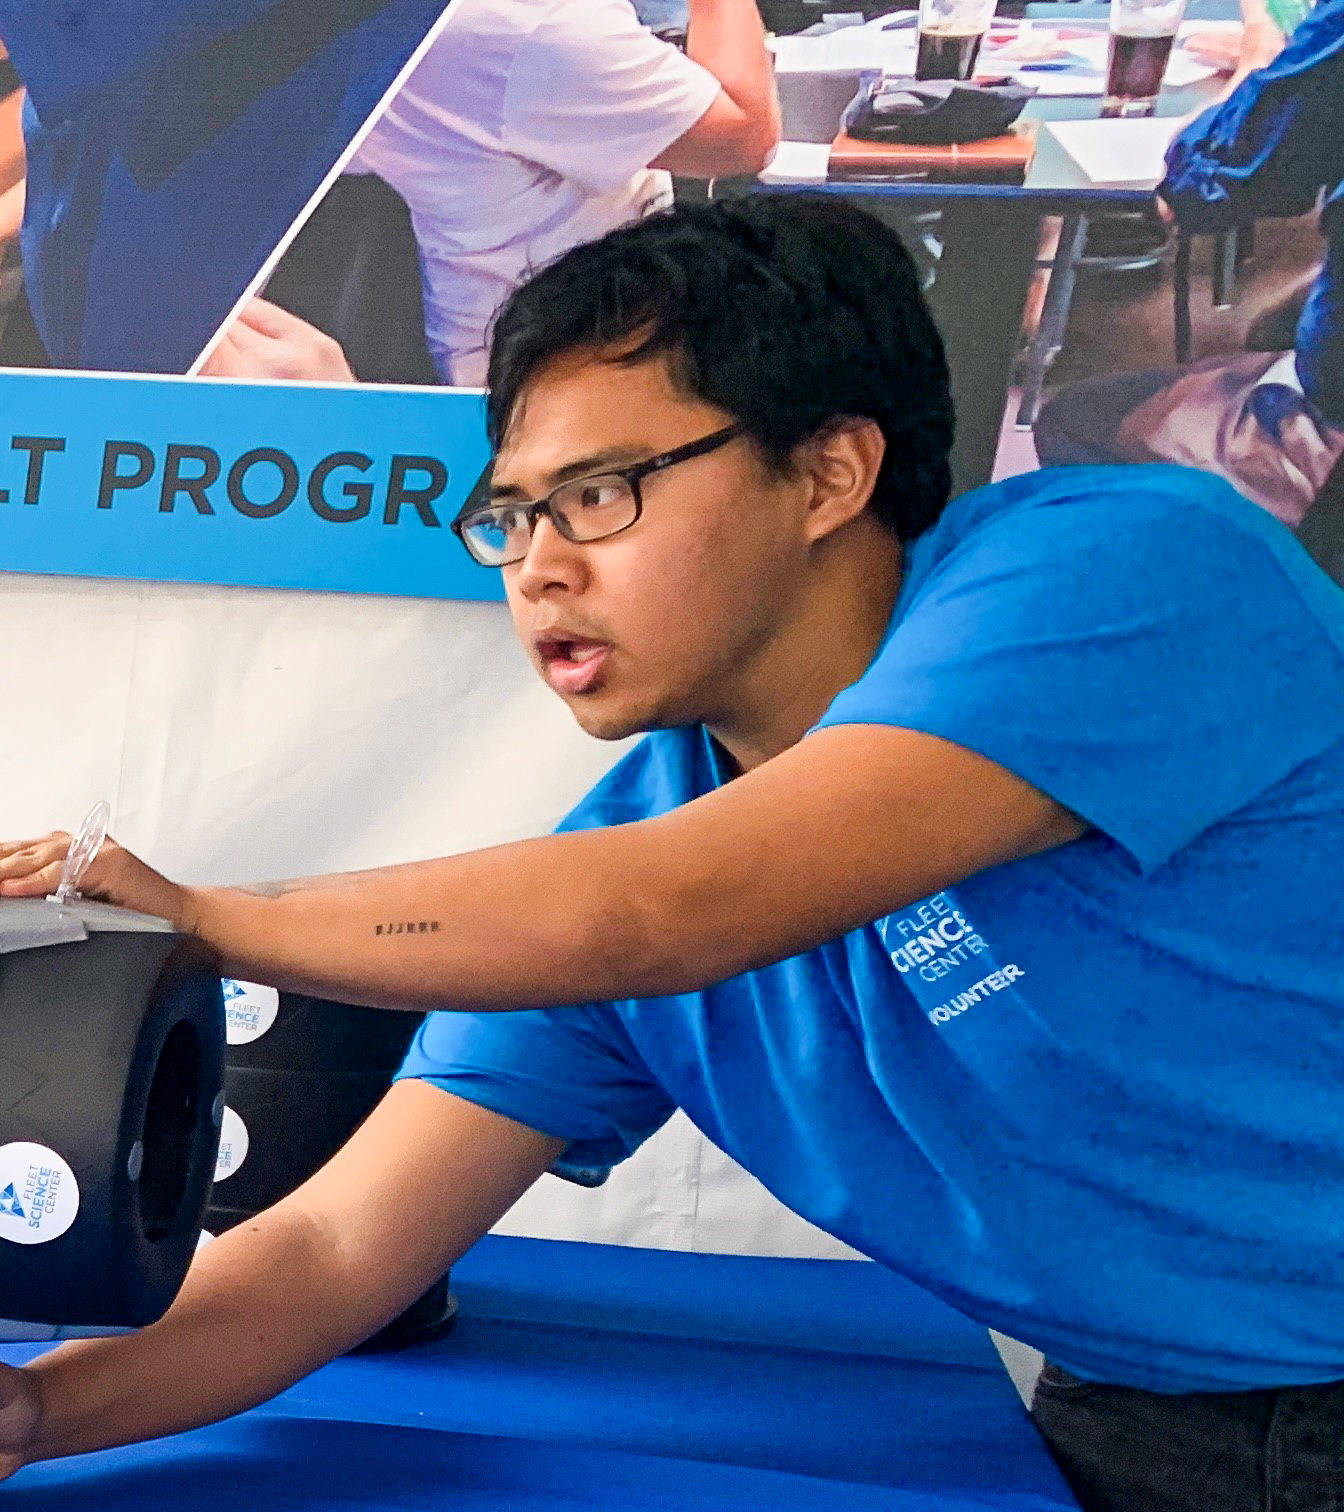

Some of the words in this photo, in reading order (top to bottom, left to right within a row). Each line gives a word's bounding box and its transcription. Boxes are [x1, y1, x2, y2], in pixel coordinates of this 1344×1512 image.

[896, 891, 950, 937] FLEE
[227, 1009, 260, 1024] ENCE
[228, 1019, 258, 1032] ENTER
[23, 1164, 38, 1200] FLEET
[28, 1167, 52, 1229] SCIENCE
[44, 1170, 62, 1214] CENTER
